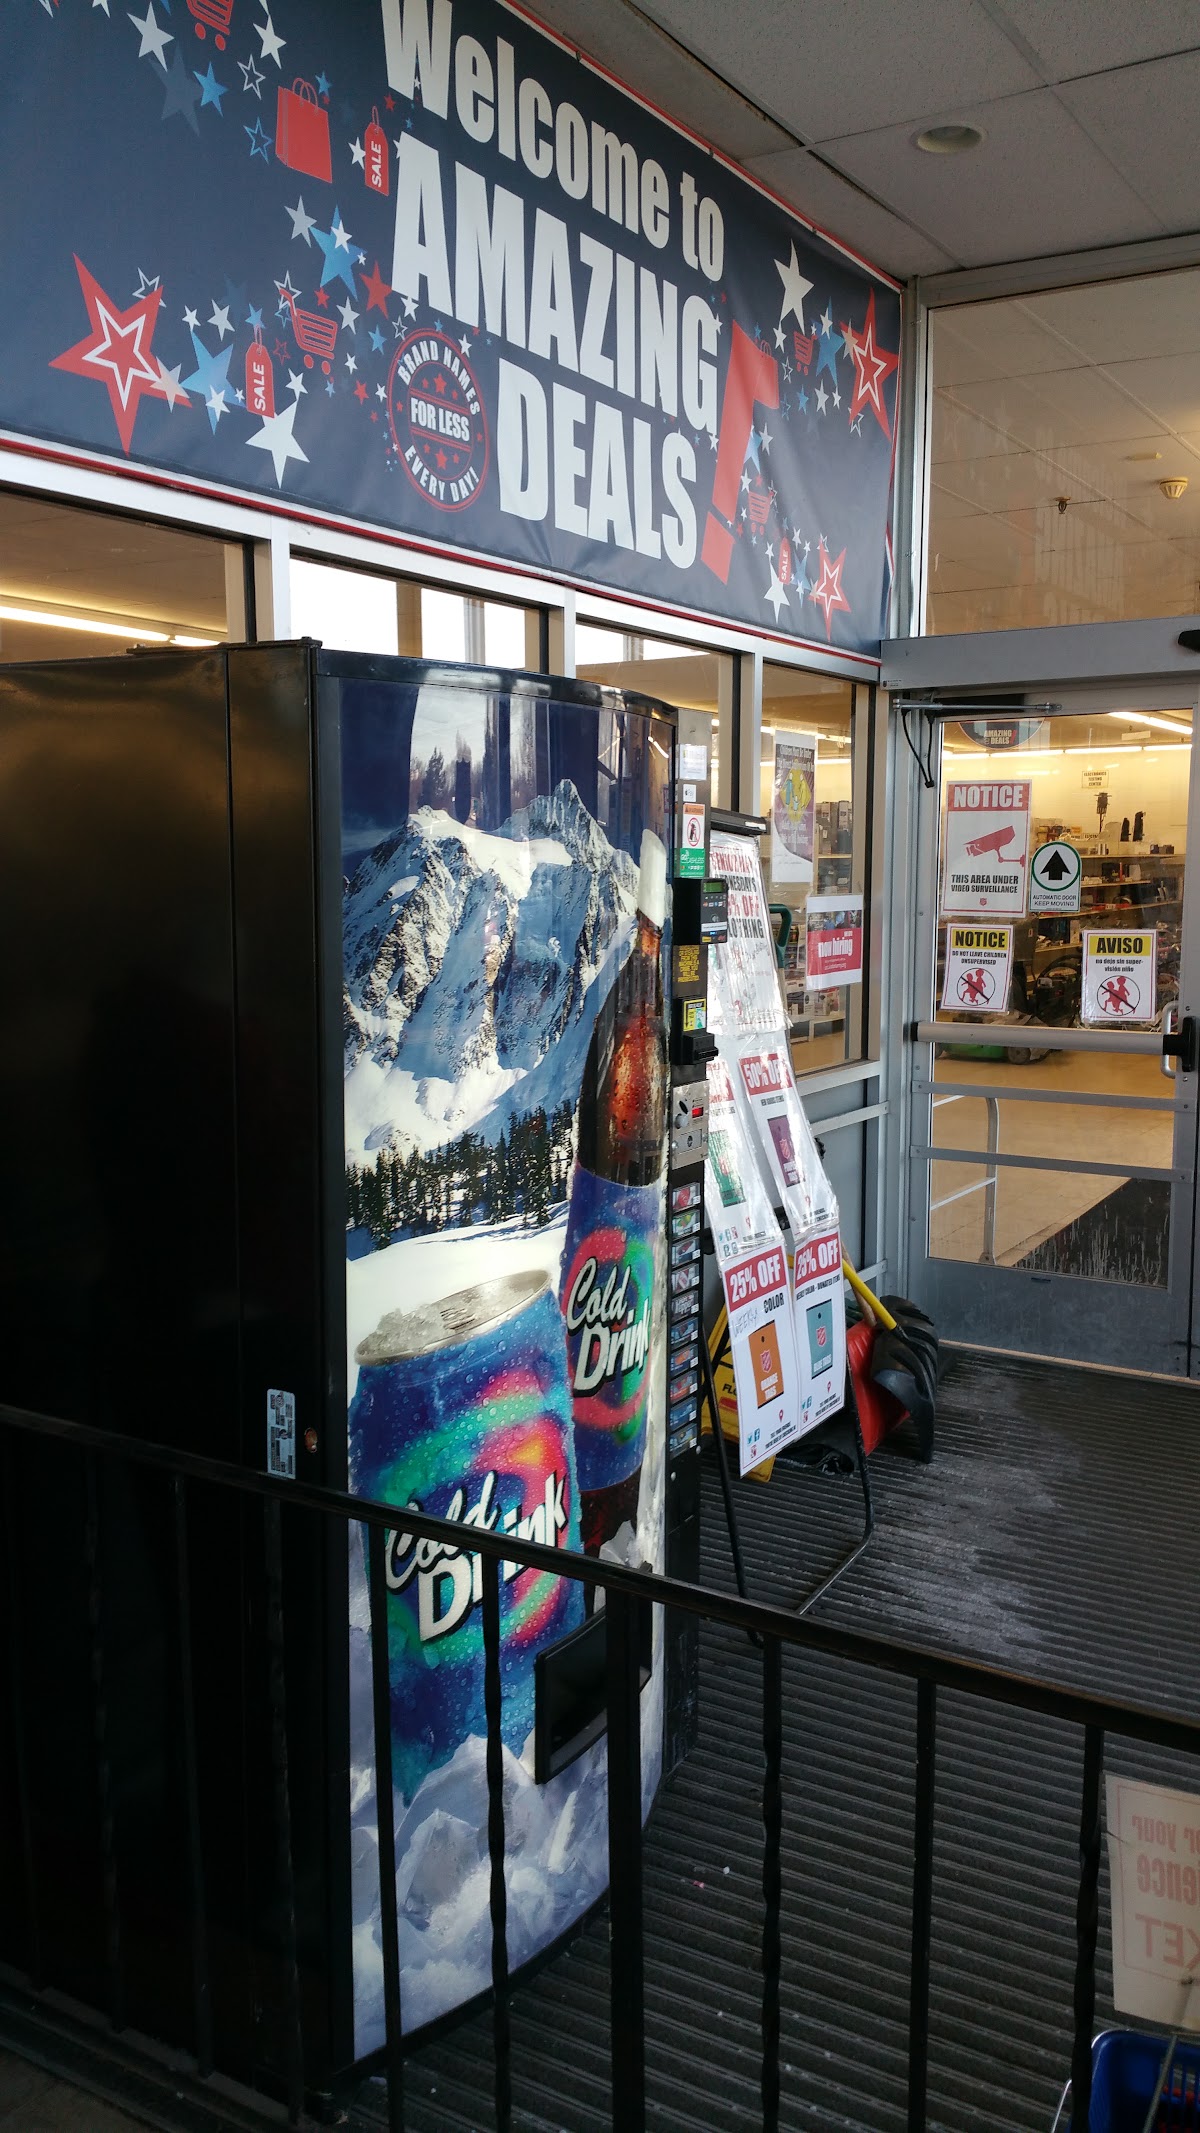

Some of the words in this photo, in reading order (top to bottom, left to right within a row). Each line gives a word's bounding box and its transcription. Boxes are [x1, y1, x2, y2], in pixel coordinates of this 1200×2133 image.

[382, 0, 670, 249] Welcome
[680, 171, 725, 282] to
[371, 139, 383, 189] SALE
[391, 131, 719, 434] AMAZING
[254, 360, 267, 412] SALE
[397, 339, 440, 386] BRAND
[443, 346, 481, 416] NAMES
[410, 397, 437, 431] FOR
[438, 407, 471, 442] LESS
[404, 444, 446, 501] EVERY
[449, 465, 480, 503] DAY!
[780, 551, 790, 581] SALE
[984, 729, 1012, 737] AMAZING
[953, 784, 1024, 809] NOTICE
[951, 874, 970, 883] THIS
[970, 874, 990, 884] AREA
[992, 875, 1019, 885] UNDER
[951, 884, 970, 893] VIDEO
[970, 884, 1018, 893] SURVEILLANCE
[728, 917, 765, 939] LOTHING
[955, 930, 1006, 948] NOTICE
[1096, 937, 1144, 954] AVISO
[983, 951, 1007, 959] CHILDREN
[743, 1061, 769, 1089] 50%
[730, 1264, 758, 1304] 25%
[757, 1253, 781, 1288] OFF
[797, 1246, 817, 1281] 25%
[817, 1238, 839, 1269] OFF
[566, 1257, 631, 1330] Cold
[763, 1292, 785, 1314] COLOR
[573, 1297, 651, 1391] Drink
[385, 1470, 498, 1590] Cold
